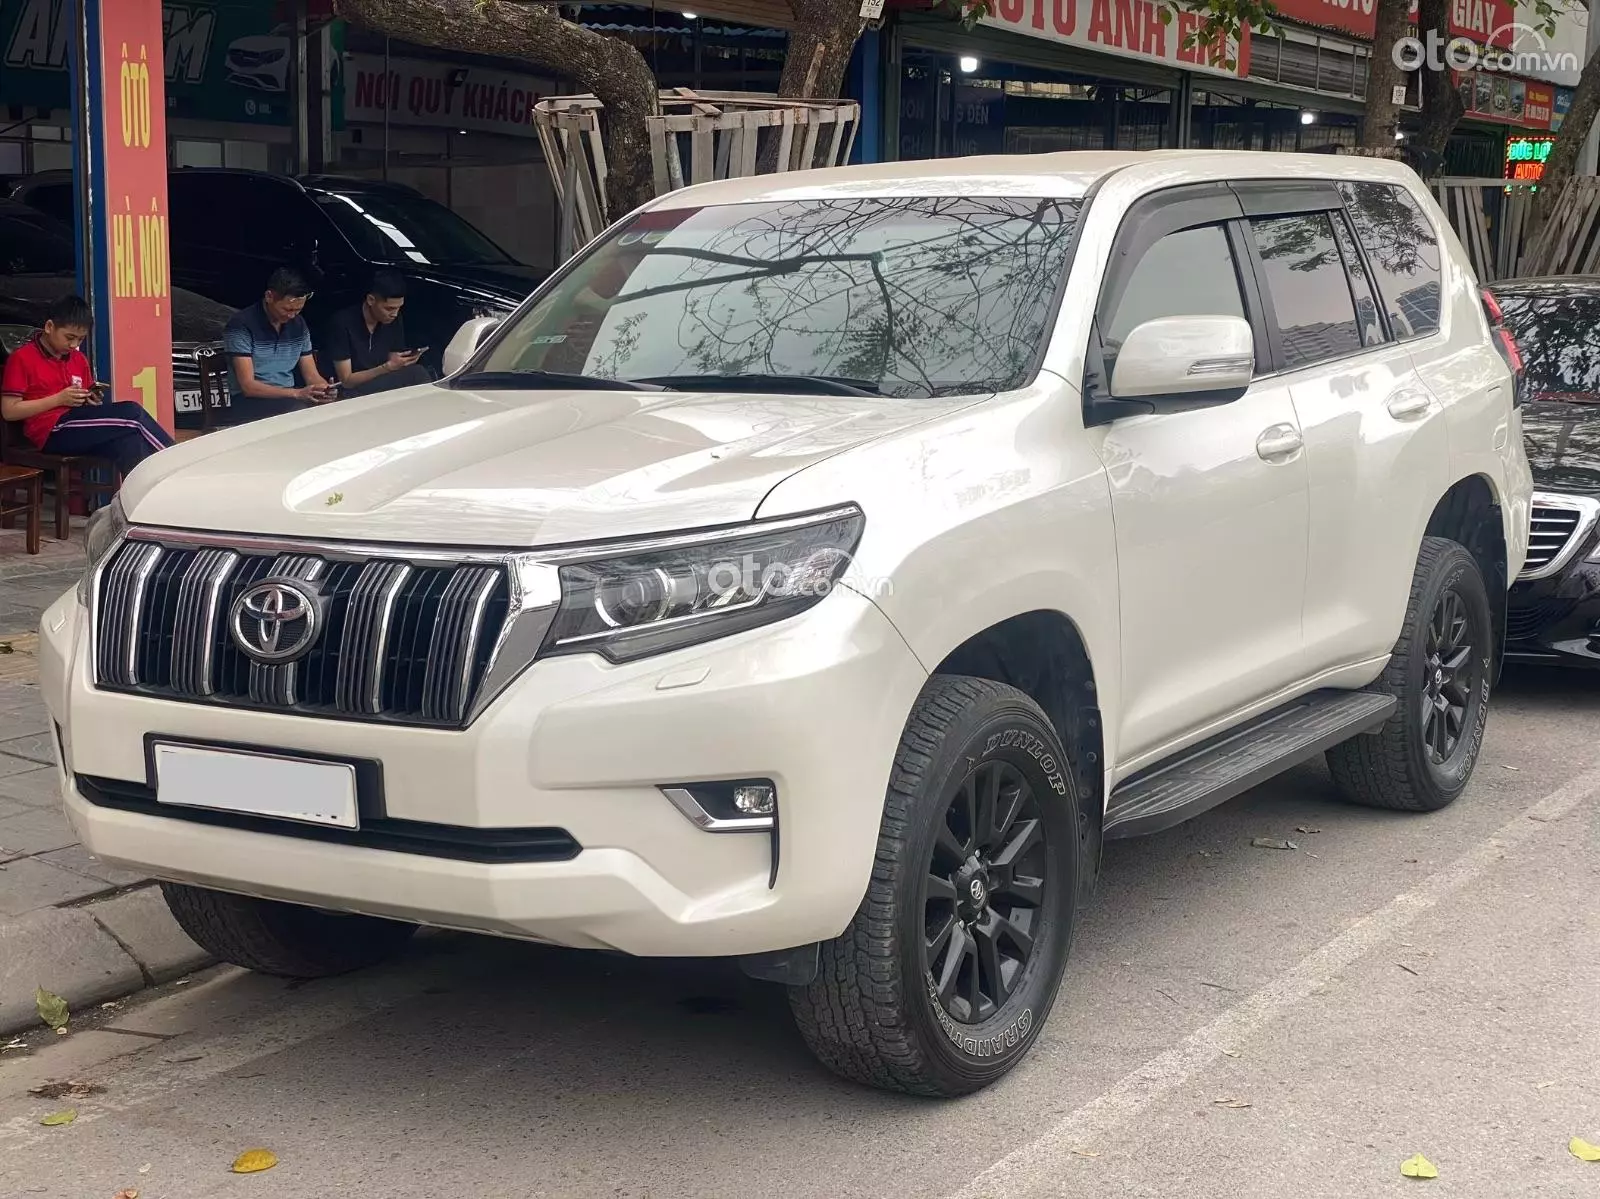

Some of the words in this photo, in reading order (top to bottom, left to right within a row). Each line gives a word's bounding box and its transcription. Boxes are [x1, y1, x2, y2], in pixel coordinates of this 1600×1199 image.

[1088, 0, 1166, 58] ANH
[120, 42, 150, 149] ÔTÔ
[113, 195, 137, 298] HÀ
[138, 197, 167, 317] NỘI
[132, 366, 158, 423] 1
[982, 729, 1066, 796] DUNLOP
